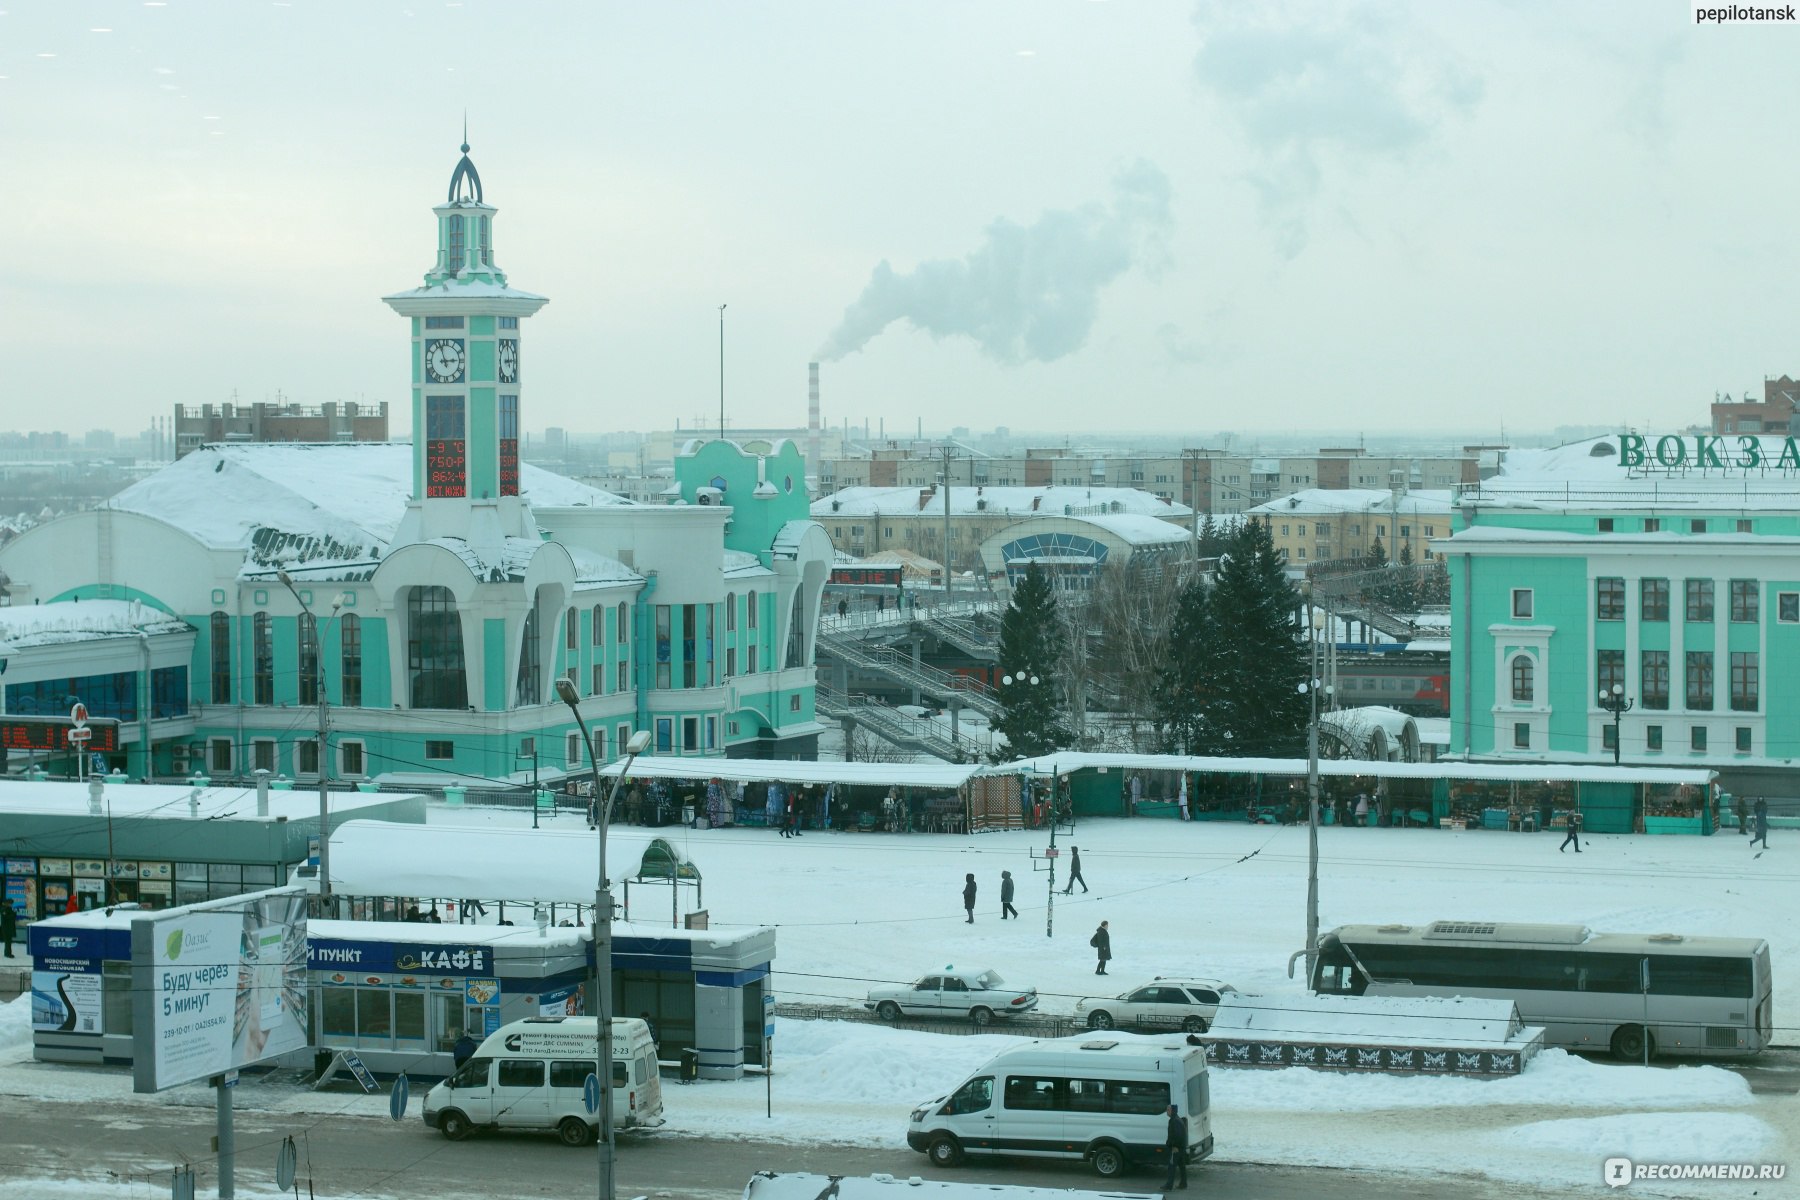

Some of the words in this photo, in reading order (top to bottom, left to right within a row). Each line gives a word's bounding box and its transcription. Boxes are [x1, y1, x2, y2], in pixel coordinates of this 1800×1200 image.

[44, 958, 90, 966] НОВОСИБИРСКИЙ
[318, 948, 362, 963] ПУНКТ
[421, 950, 484, 970] КАФЕ
[163, 972, 192, 995] Буду
[194, 963, 229, 986] через
[164, 997, 172, 1017] 5
[174, 992, 211, 1014] минут
[195, 1016, 227, 1031] OAZIS54.RU
